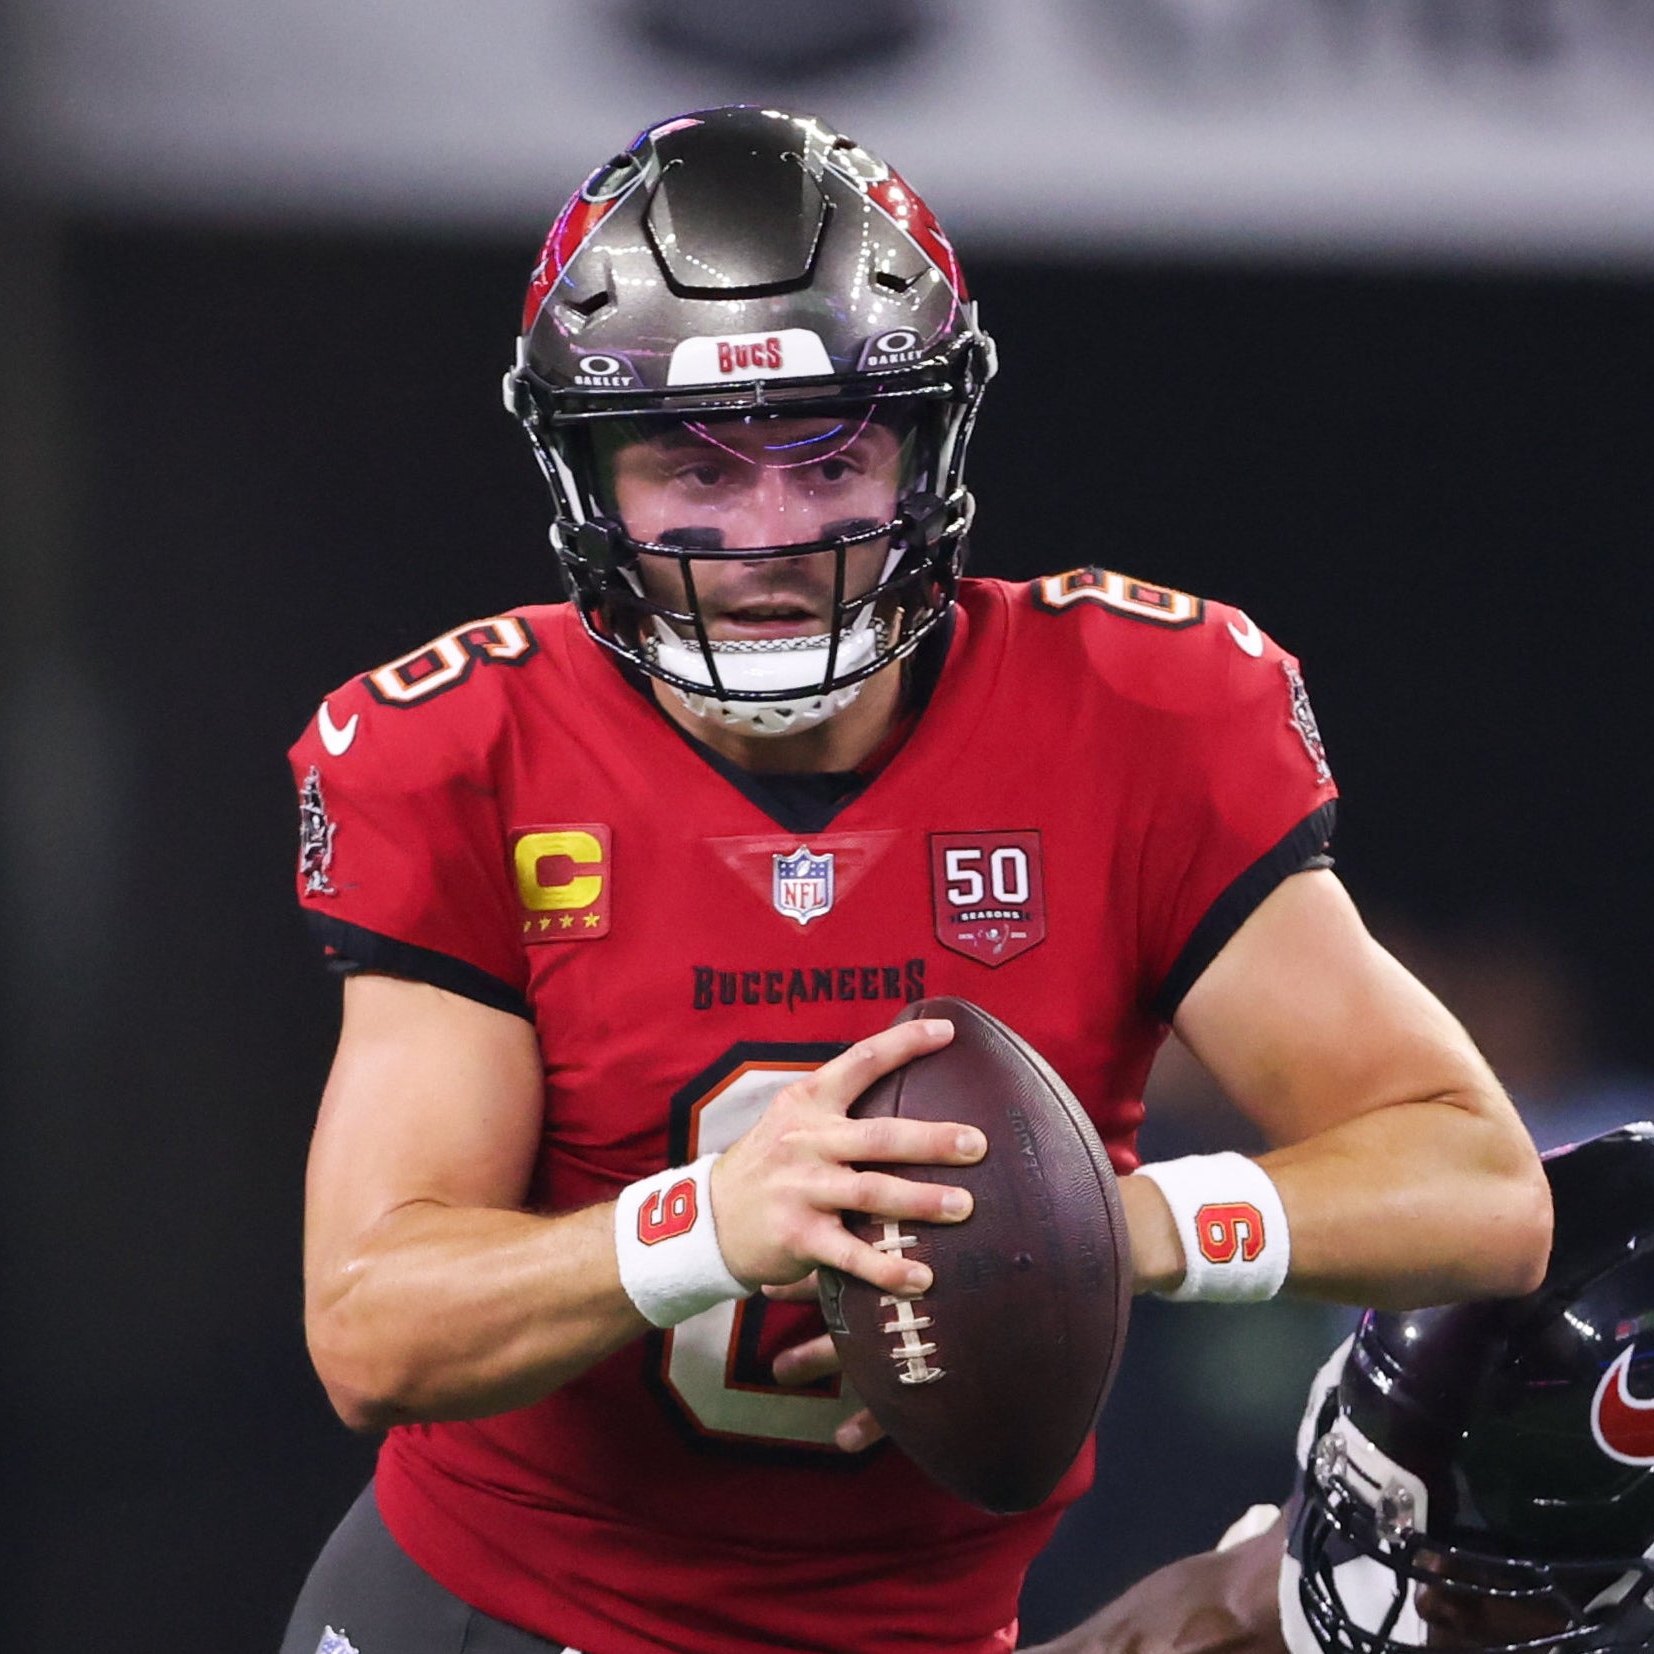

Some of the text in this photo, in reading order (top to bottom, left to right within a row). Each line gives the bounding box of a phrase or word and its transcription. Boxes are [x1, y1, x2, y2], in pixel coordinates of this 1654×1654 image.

[717, 337, 785, 375] BUCS
[867, 350, 925, 367] OAKLEY
[574, 375, 634, 388] OAKLEY
[361, 614, 541, 709] 6
[514, 830, 603, 911] C
[944, 846, 1031, 907] 50
[783, 882, 824, 910] NFL
[961, 910, 1021, 922] SEASONS
[692, 958, 926, 1013] BUCCANEERS
